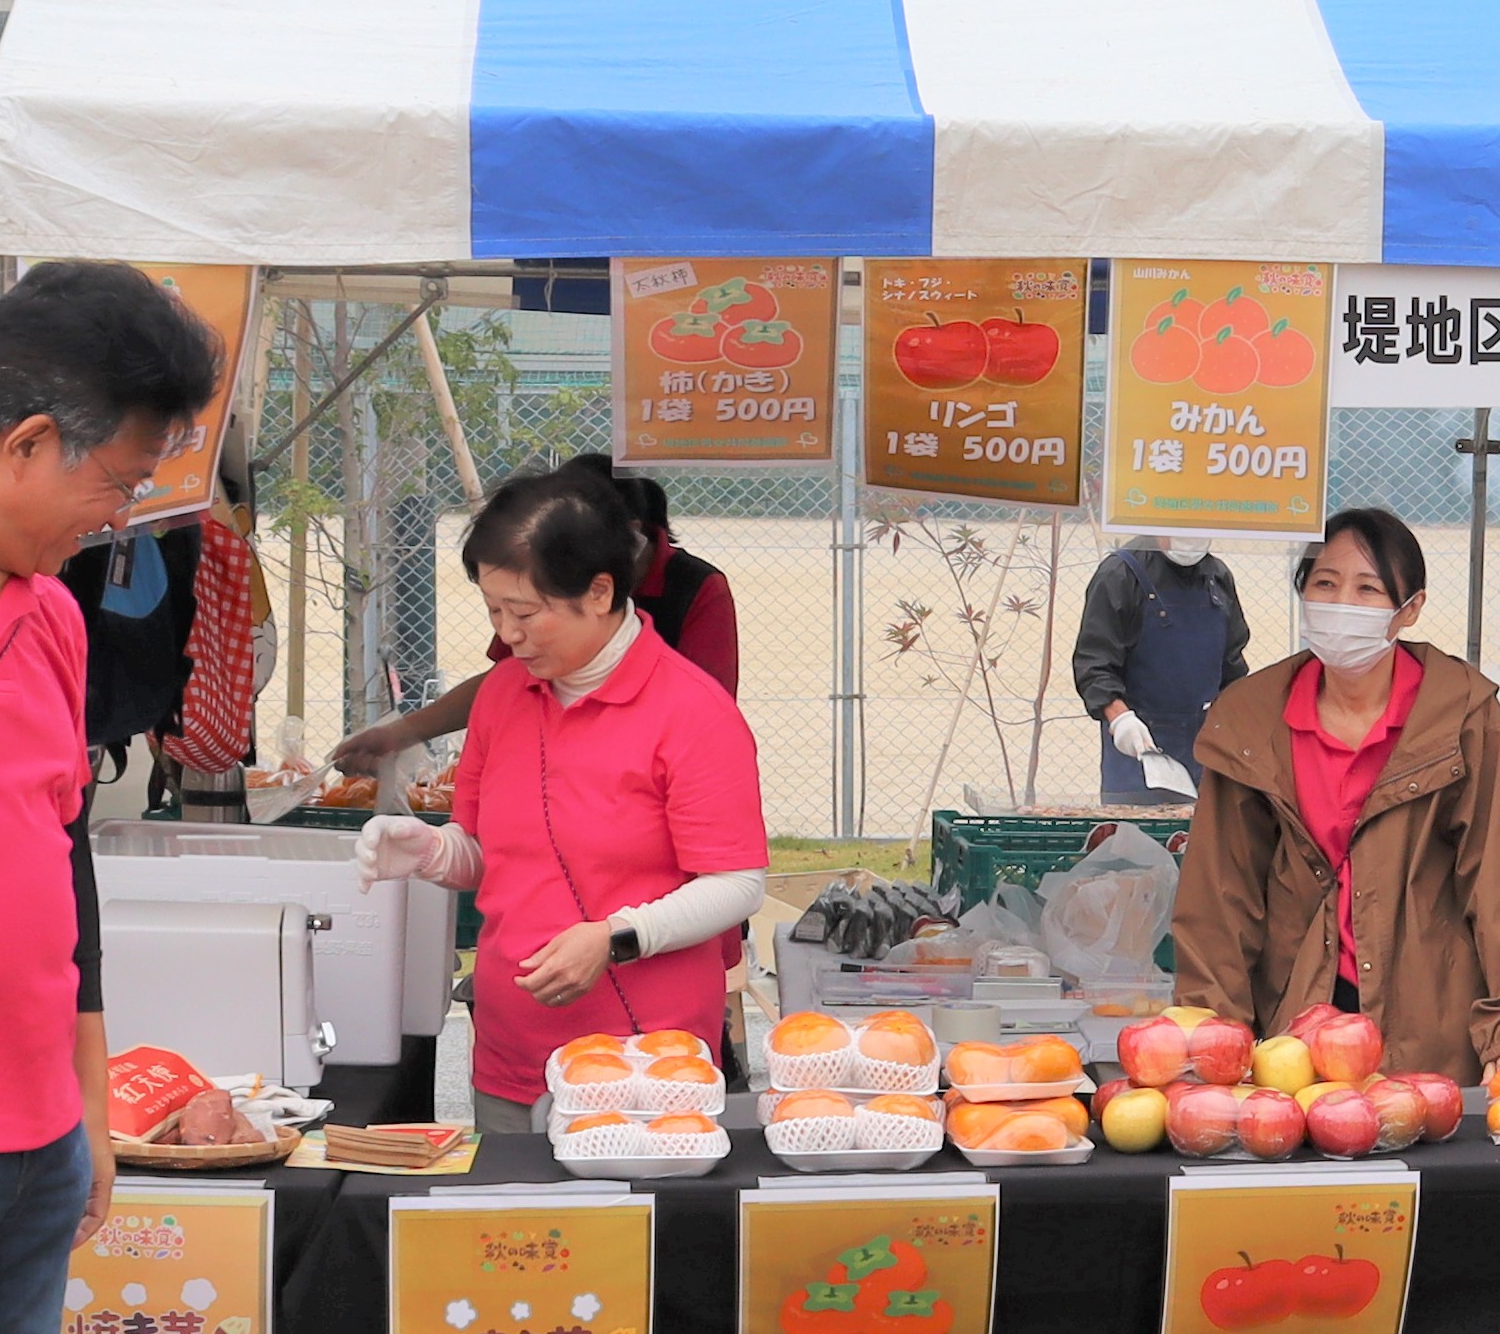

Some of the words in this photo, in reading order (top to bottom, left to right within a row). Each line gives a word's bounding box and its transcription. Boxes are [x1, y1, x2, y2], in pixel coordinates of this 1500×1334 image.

[1133, 268, 1191, 280] 山川みかん
[641, 399, 693, 422] 1袋
[716, 397, 816, 421] 500円
[930, 401, 1018, 428] リンゴ
[1170, 400, 1265, 436] みかん
[887, 431, 939, 458] 1袋
[963, 436, 1066, 466] 500円
[1132, 439, 1184, 473] 1袋
[1206, 443, 1308, 479] 500円
